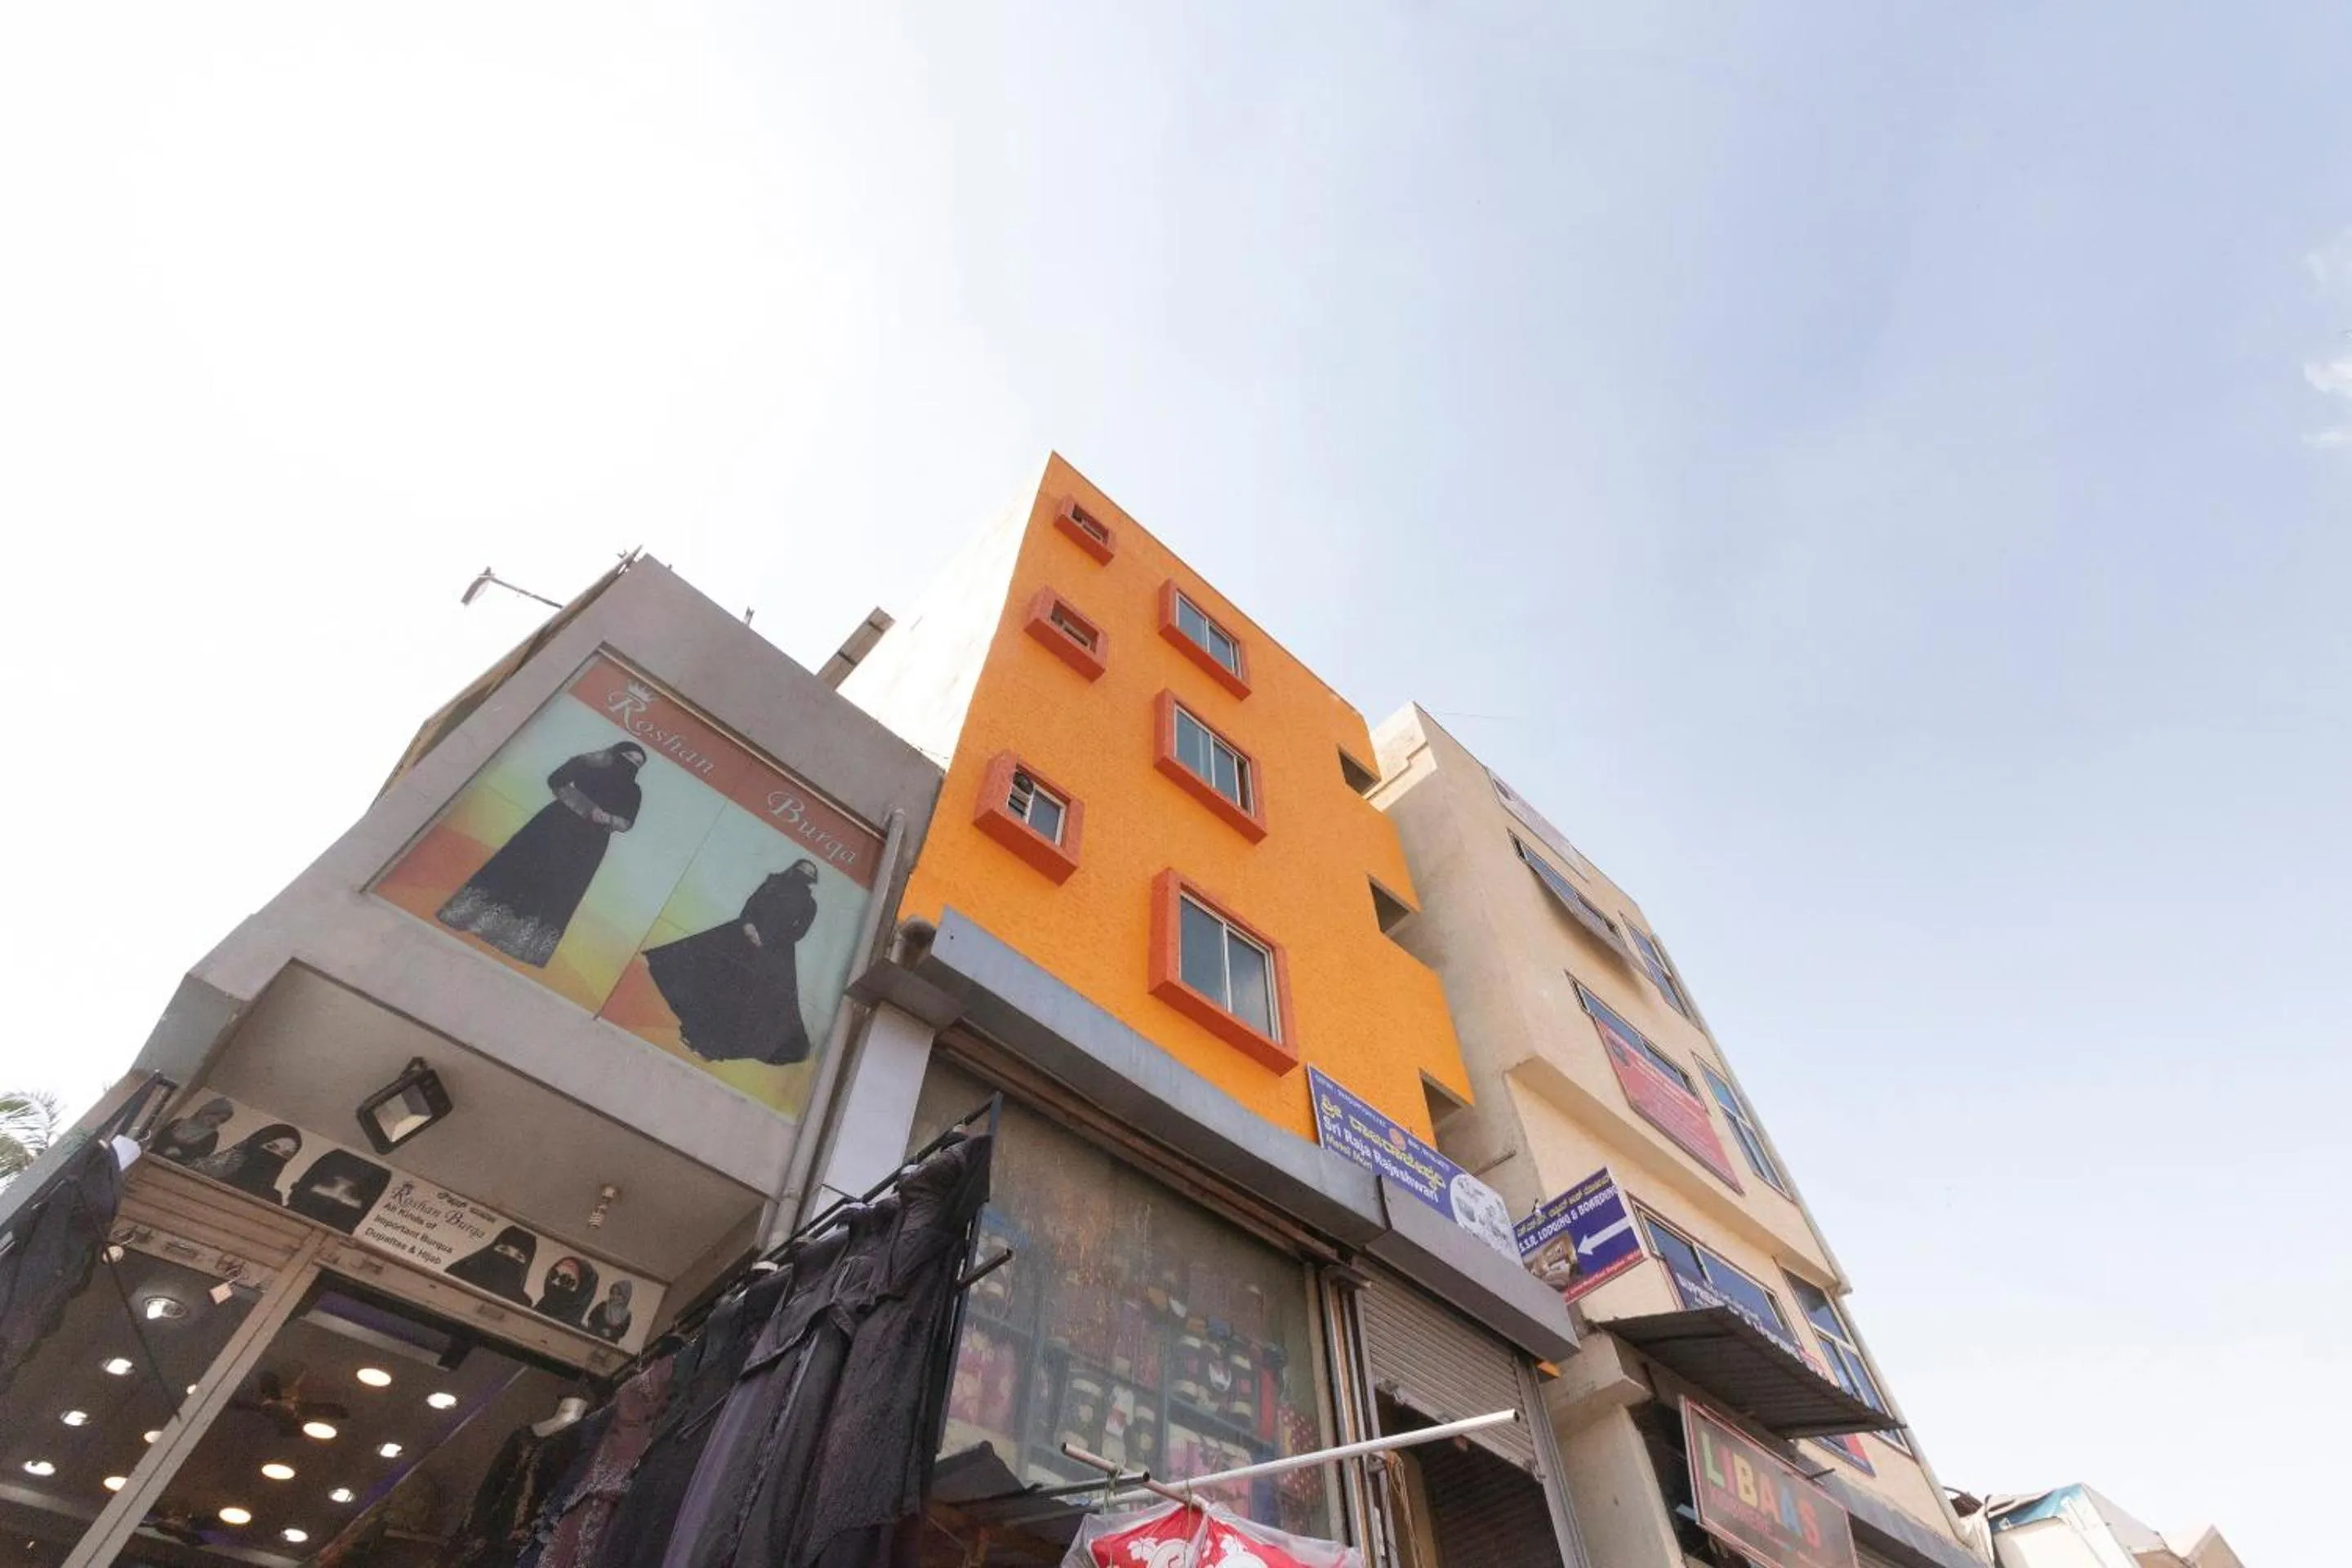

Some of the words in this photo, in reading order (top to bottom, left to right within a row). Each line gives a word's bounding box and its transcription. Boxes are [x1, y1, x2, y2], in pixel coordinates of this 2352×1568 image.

[608, 690, 716, 777] Roshan
[767, 791, 857, 866] Burqa
[1323, 1115, 1341, 1137] Sri
[1343, 1128, 1372, 1159] Raja
[384, 1202, 397, 1213] All
[426, 1221, 437, 1230] of
[391, 1183, 442, 1218] Roshan
[444, 1209, 487, 1240] Burqa
[417, 1249, 442, 1264] Hijab
[1700, 1431, 1822, 1549] LIBAAS
